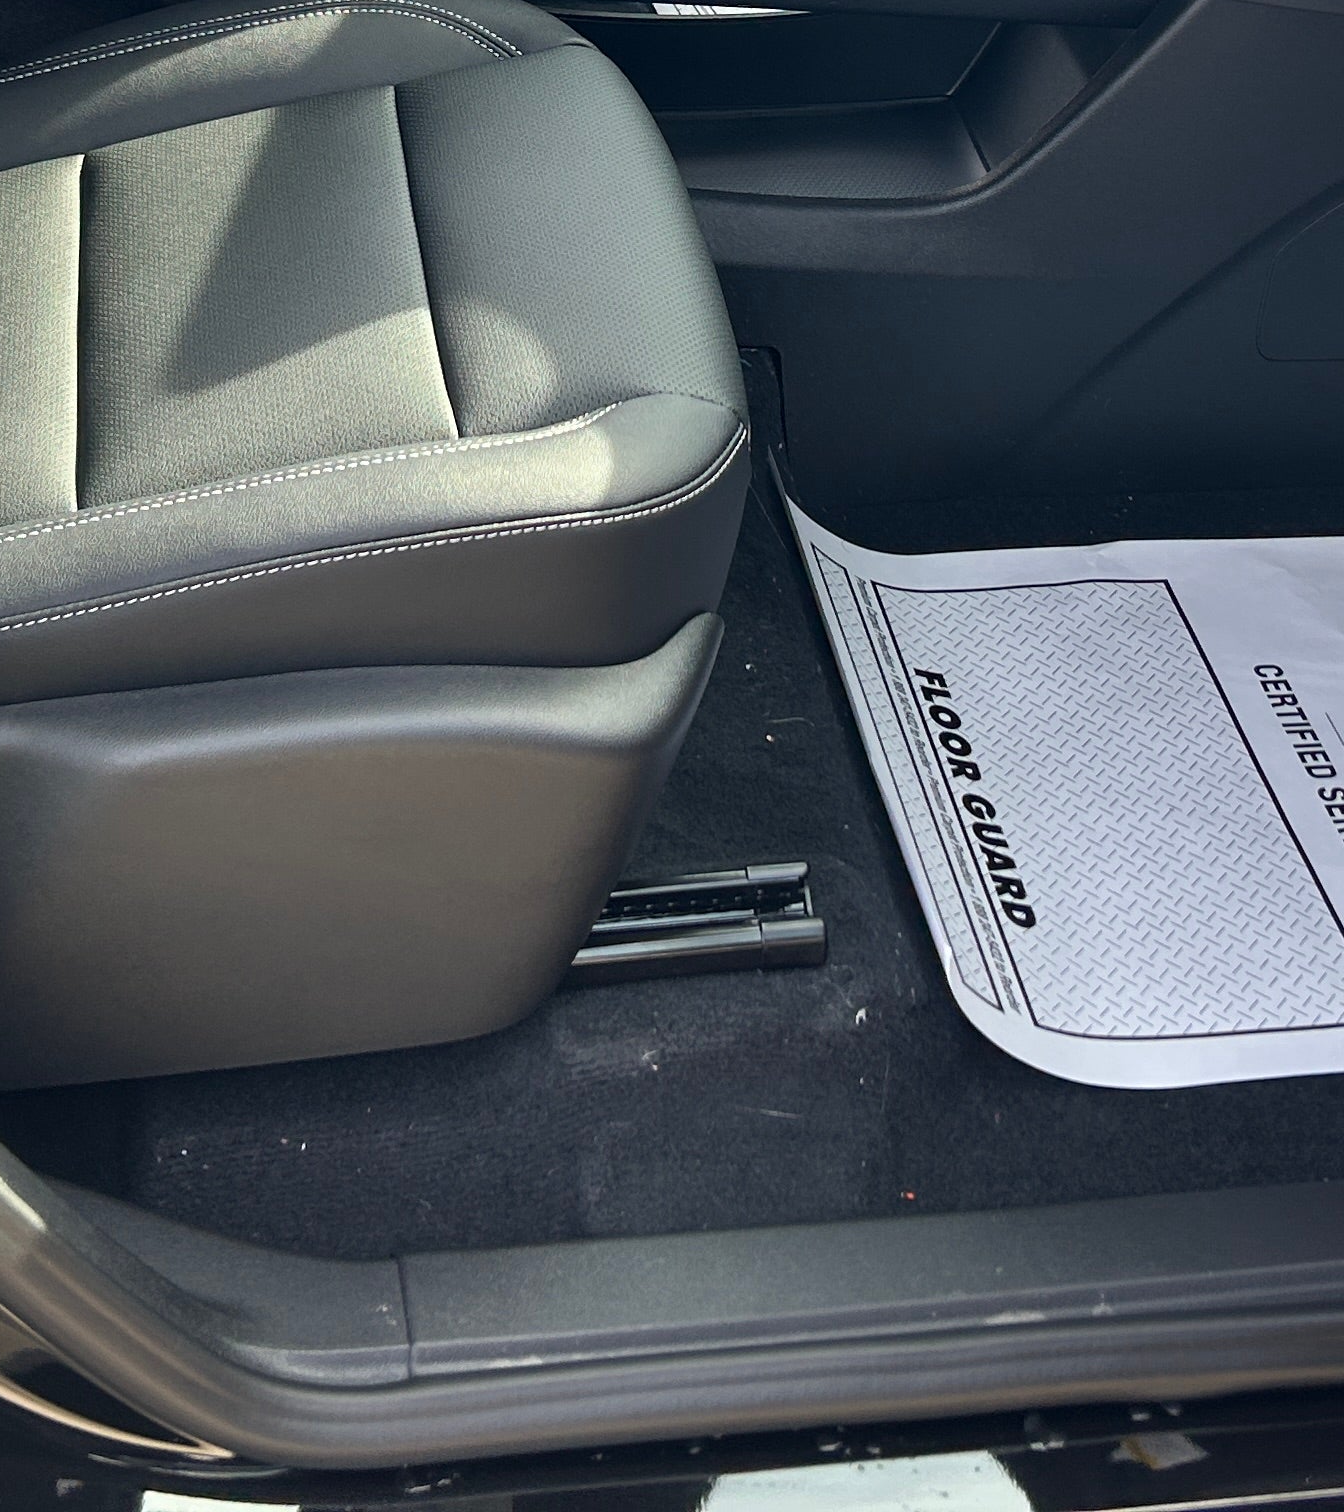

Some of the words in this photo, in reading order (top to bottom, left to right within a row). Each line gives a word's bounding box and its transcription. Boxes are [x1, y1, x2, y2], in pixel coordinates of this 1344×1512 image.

[913, 667, 982, 782] FLOOR
[962, 792, 1037, 929] GUARD
[1253, 663, 1338, 779] CERTIFIED
